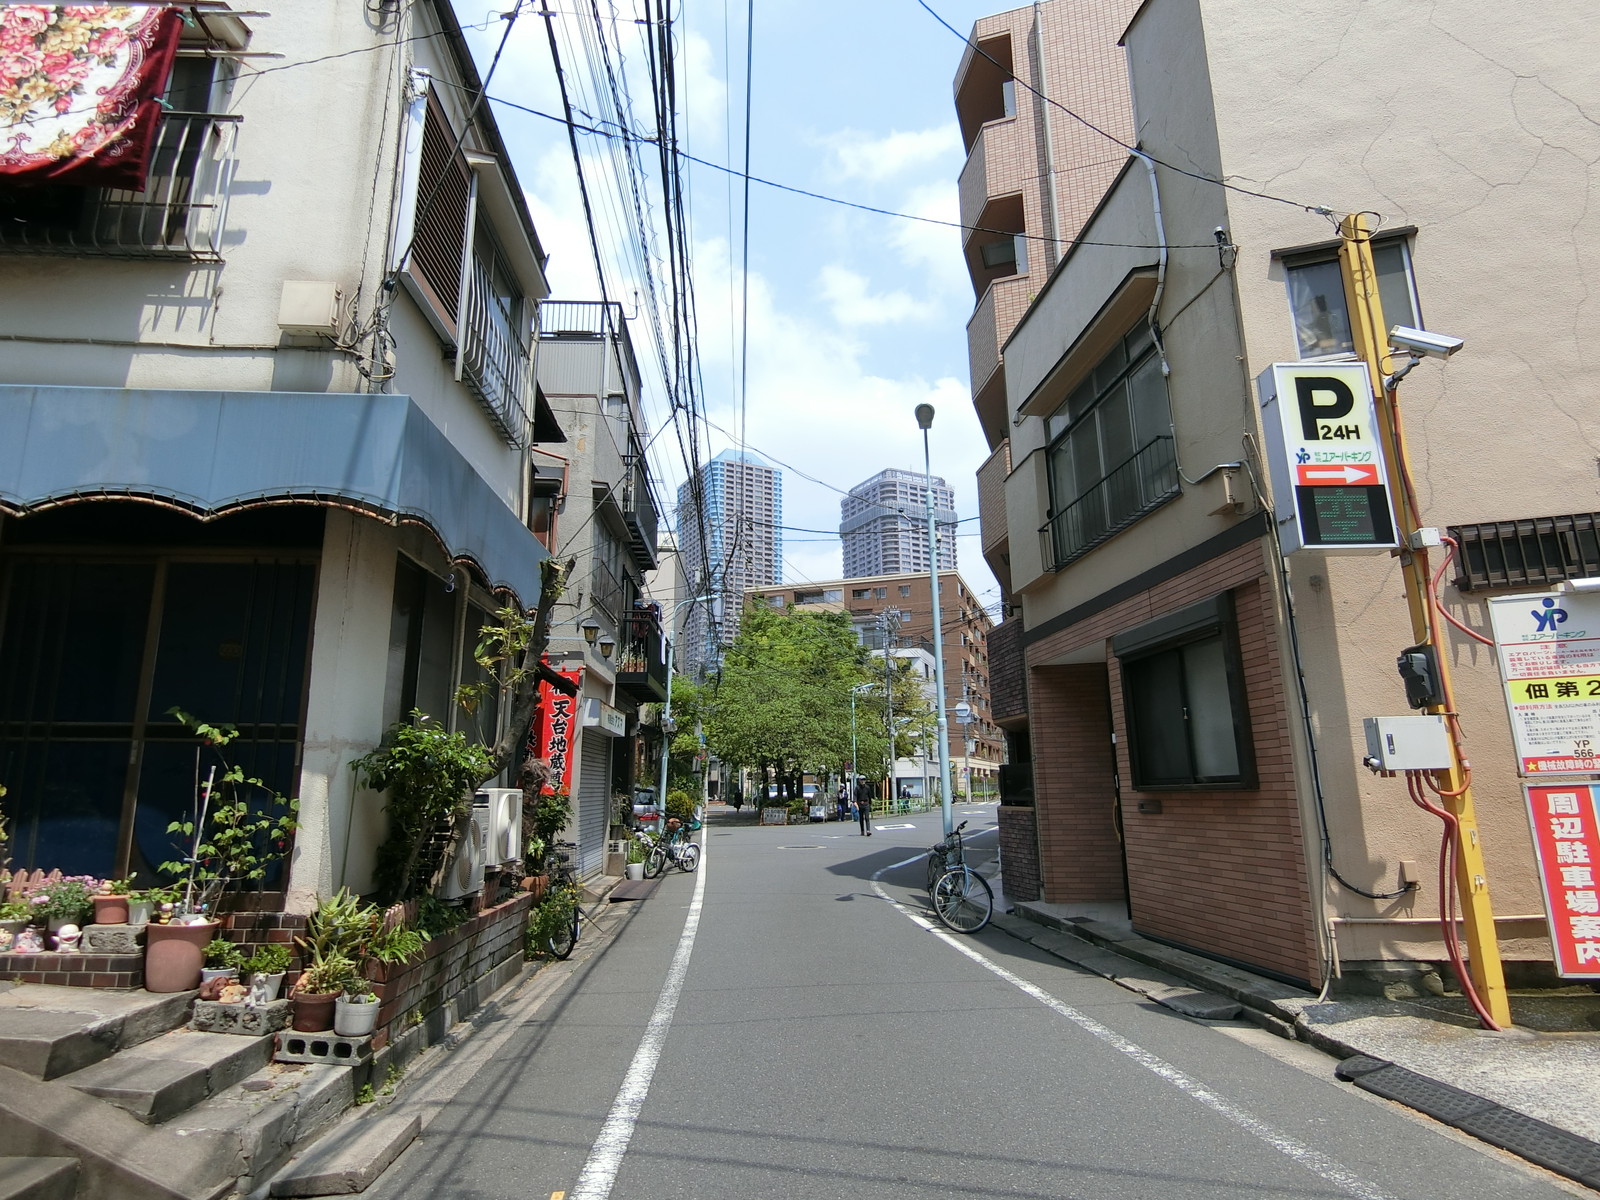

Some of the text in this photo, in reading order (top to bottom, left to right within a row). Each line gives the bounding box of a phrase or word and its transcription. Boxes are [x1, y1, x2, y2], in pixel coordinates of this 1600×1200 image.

[1295, 377, 1354, 440] P
[1320, 425, 1360, 440] 24H
[1314, 488, 1376, 541] 空
[1574, 740, 1590, 748] YP
[1574, 749, 1594, 758] 566
[1546, 792, 1600, 964] 周辺駐車場案内
